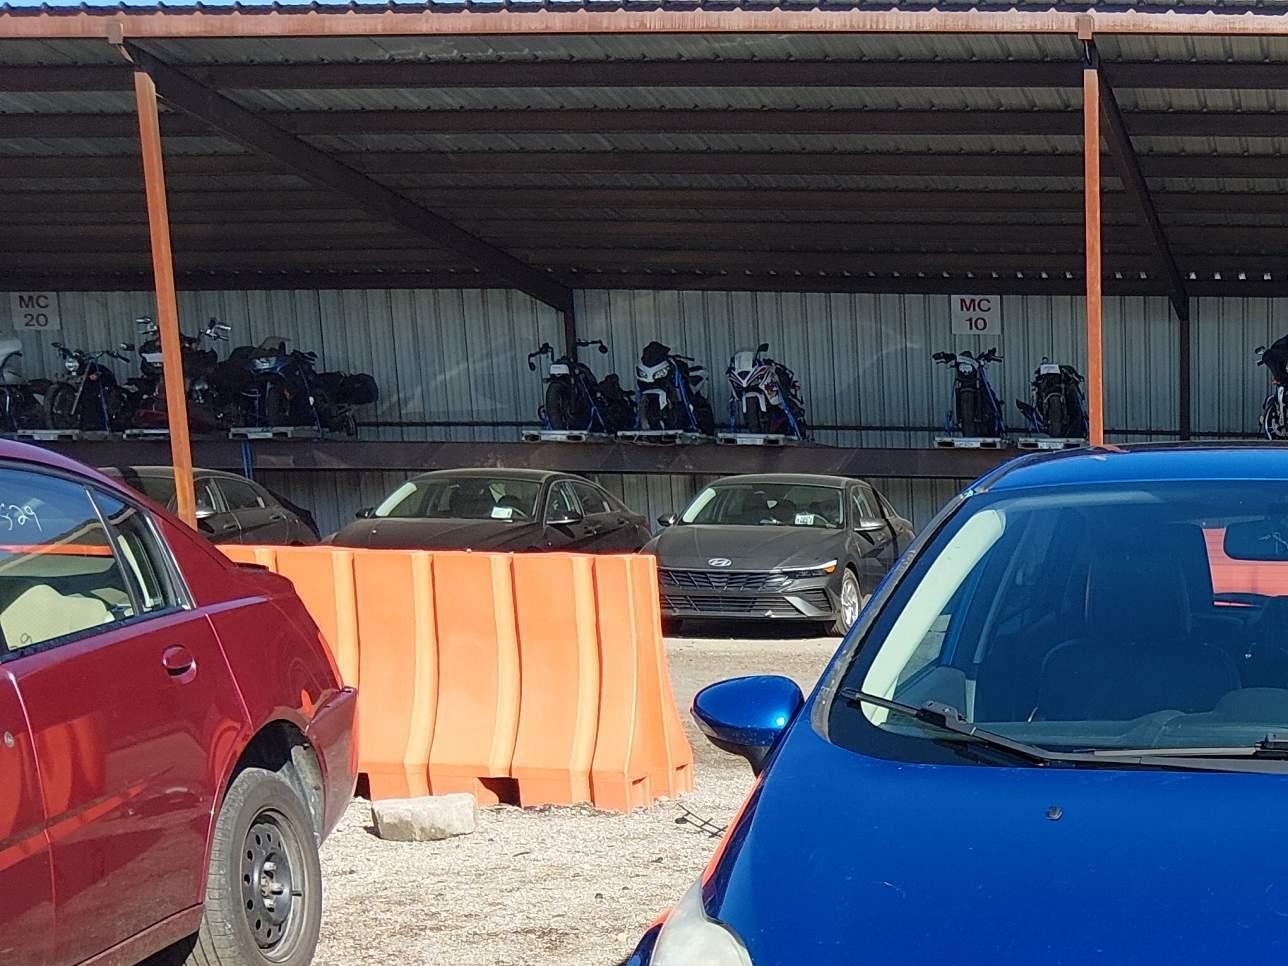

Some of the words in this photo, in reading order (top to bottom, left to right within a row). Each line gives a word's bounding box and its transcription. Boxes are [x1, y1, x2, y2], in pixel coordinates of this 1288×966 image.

[18, 295, 49, 309] MC
[959, 298, 992, 312] MC
[23, 313, 49, 327] 20
[964, 317, 988, 331] 10
